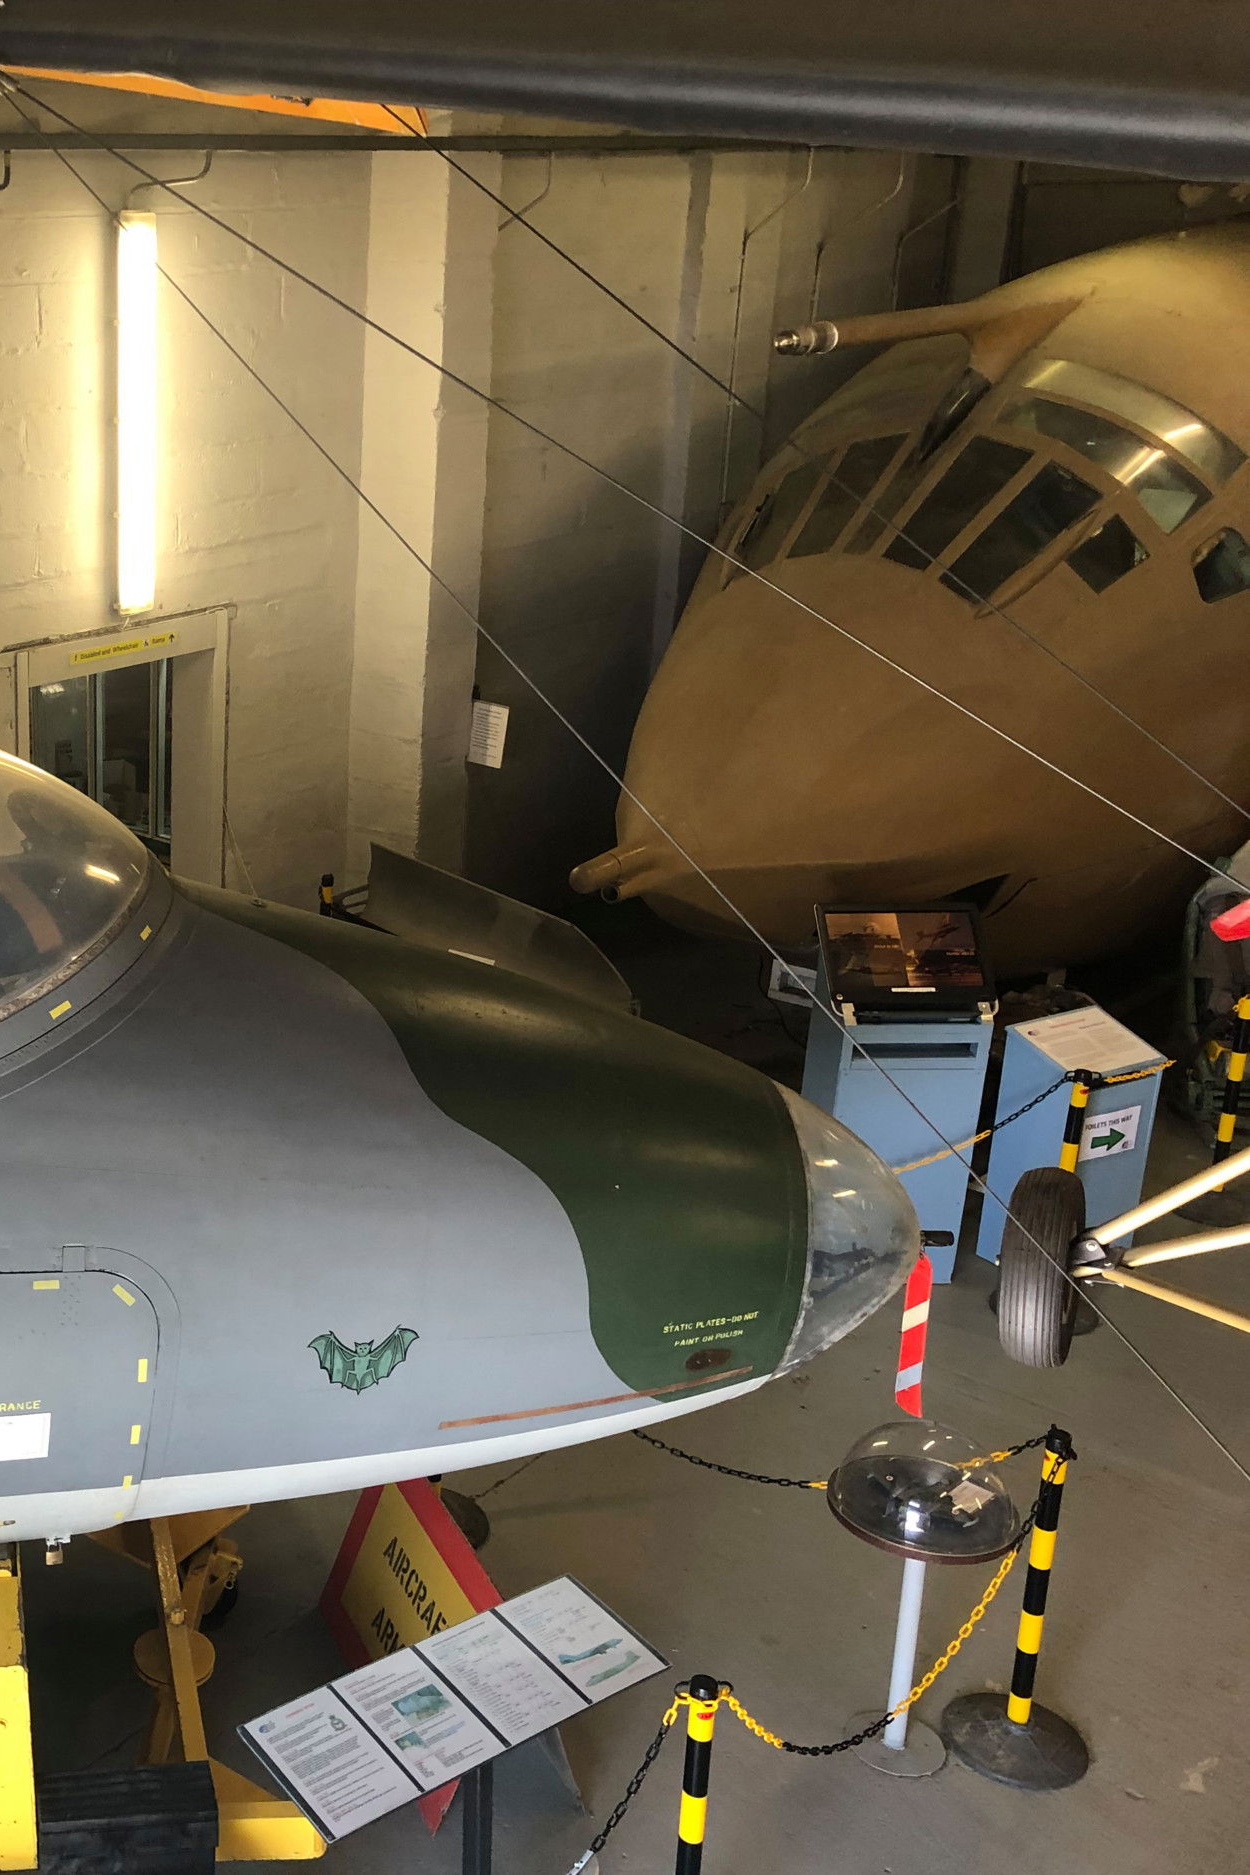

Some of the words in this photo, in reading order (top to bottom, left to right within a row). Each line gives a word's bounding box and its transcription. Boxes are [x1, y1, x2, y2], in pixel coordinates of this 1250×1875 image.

[662, 1322, 694, 1334] STATIC
[743, 1311, 759, 1320] NOT
[674, 1337, 700, 1348] PAINT
[383, 1536, 449, 1635] AIRCRAF
